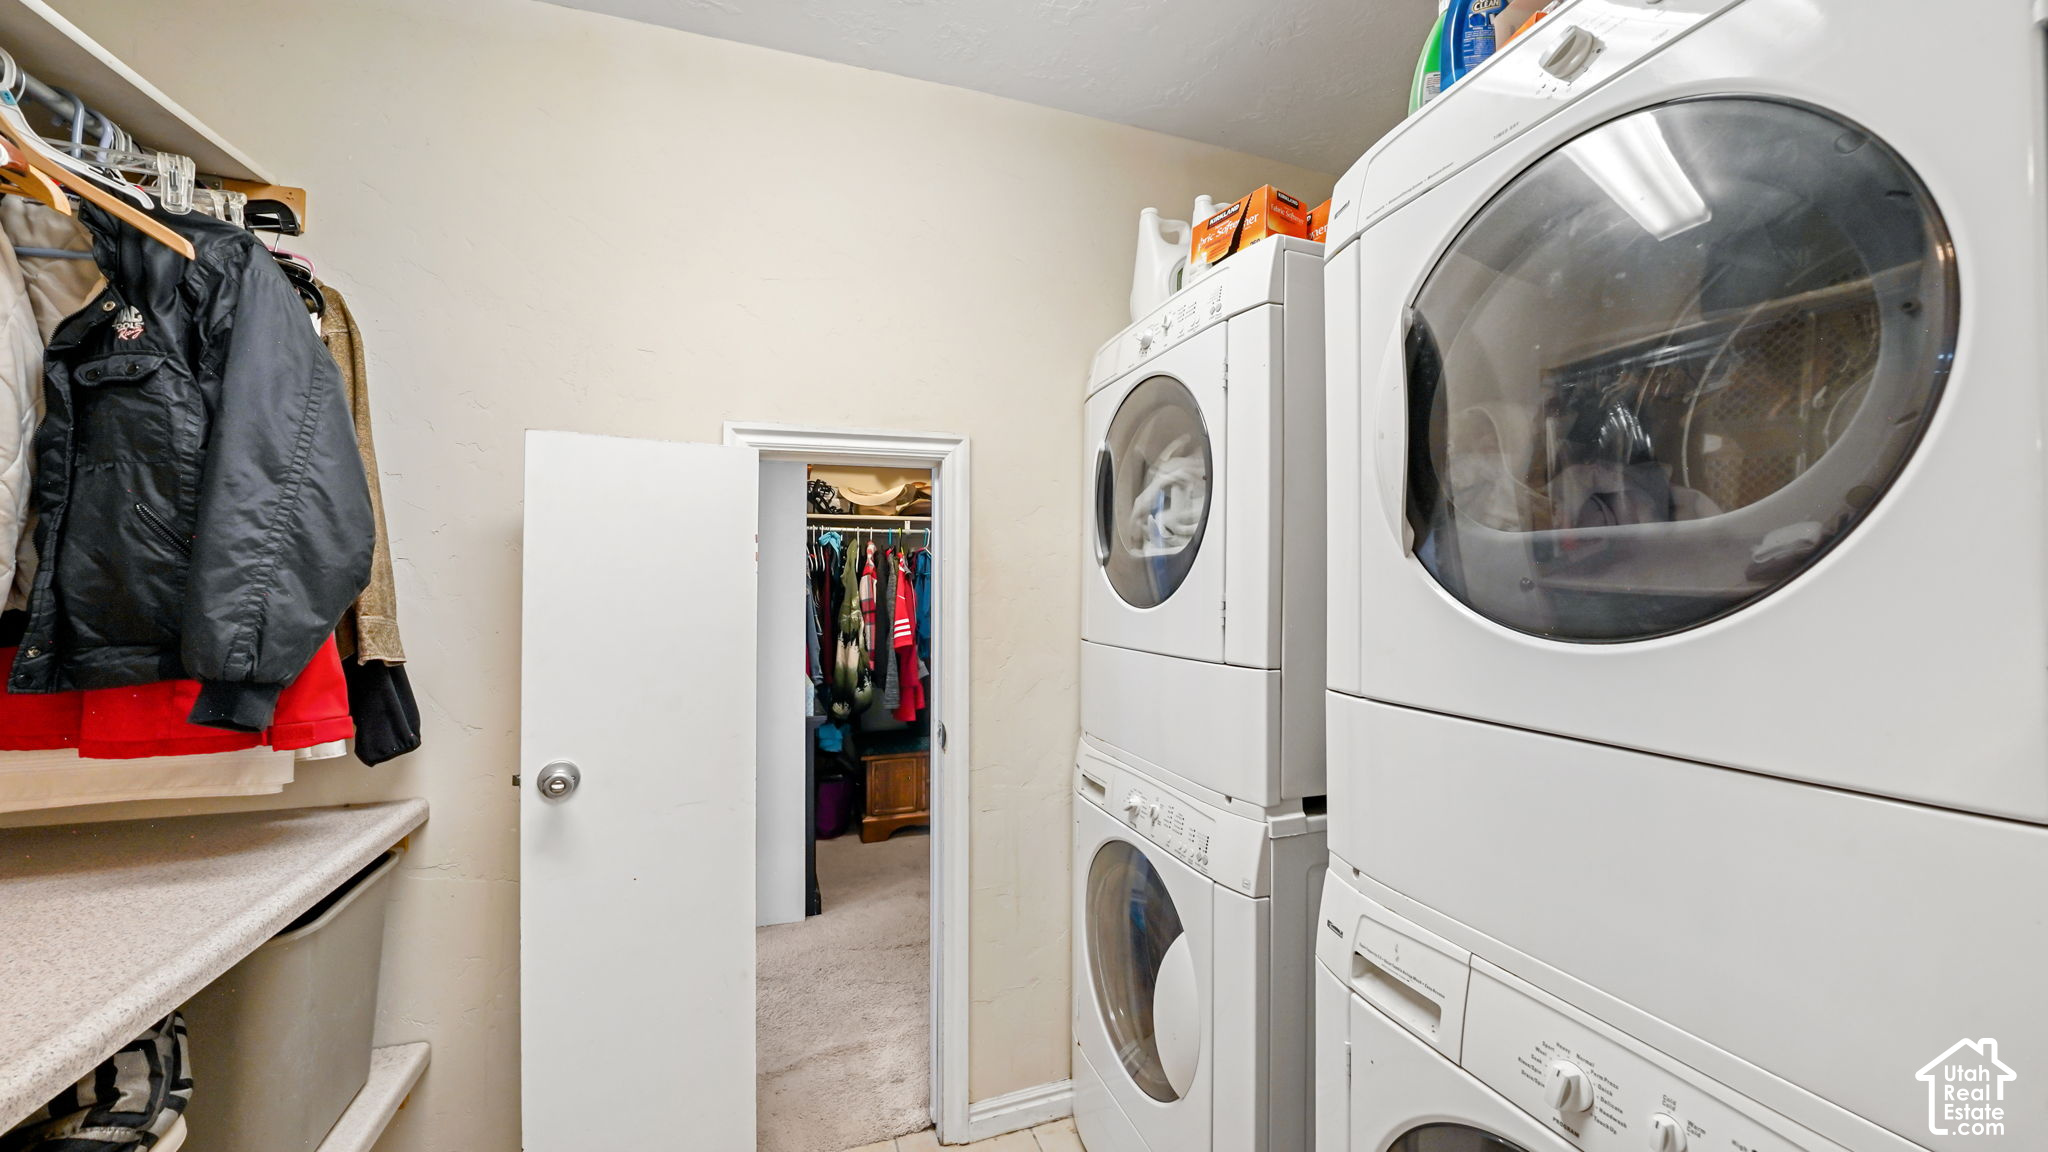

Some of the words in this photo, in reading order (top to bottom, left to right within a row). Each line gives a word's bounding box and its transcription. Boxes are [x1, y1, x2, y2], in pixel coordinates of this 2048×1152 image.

[1277, 191, 1299, 206] KIRKLAND
[1209, 203, 1240, 226] KIRKLAND
[1576, 1053, 1595, 1068] Normal
[1597, 1083, 1613, 1097] Quick
[1600, 1096, 1623, 1114] Delicate
[1552, 1116, 1580, 1138] PROGRAM
